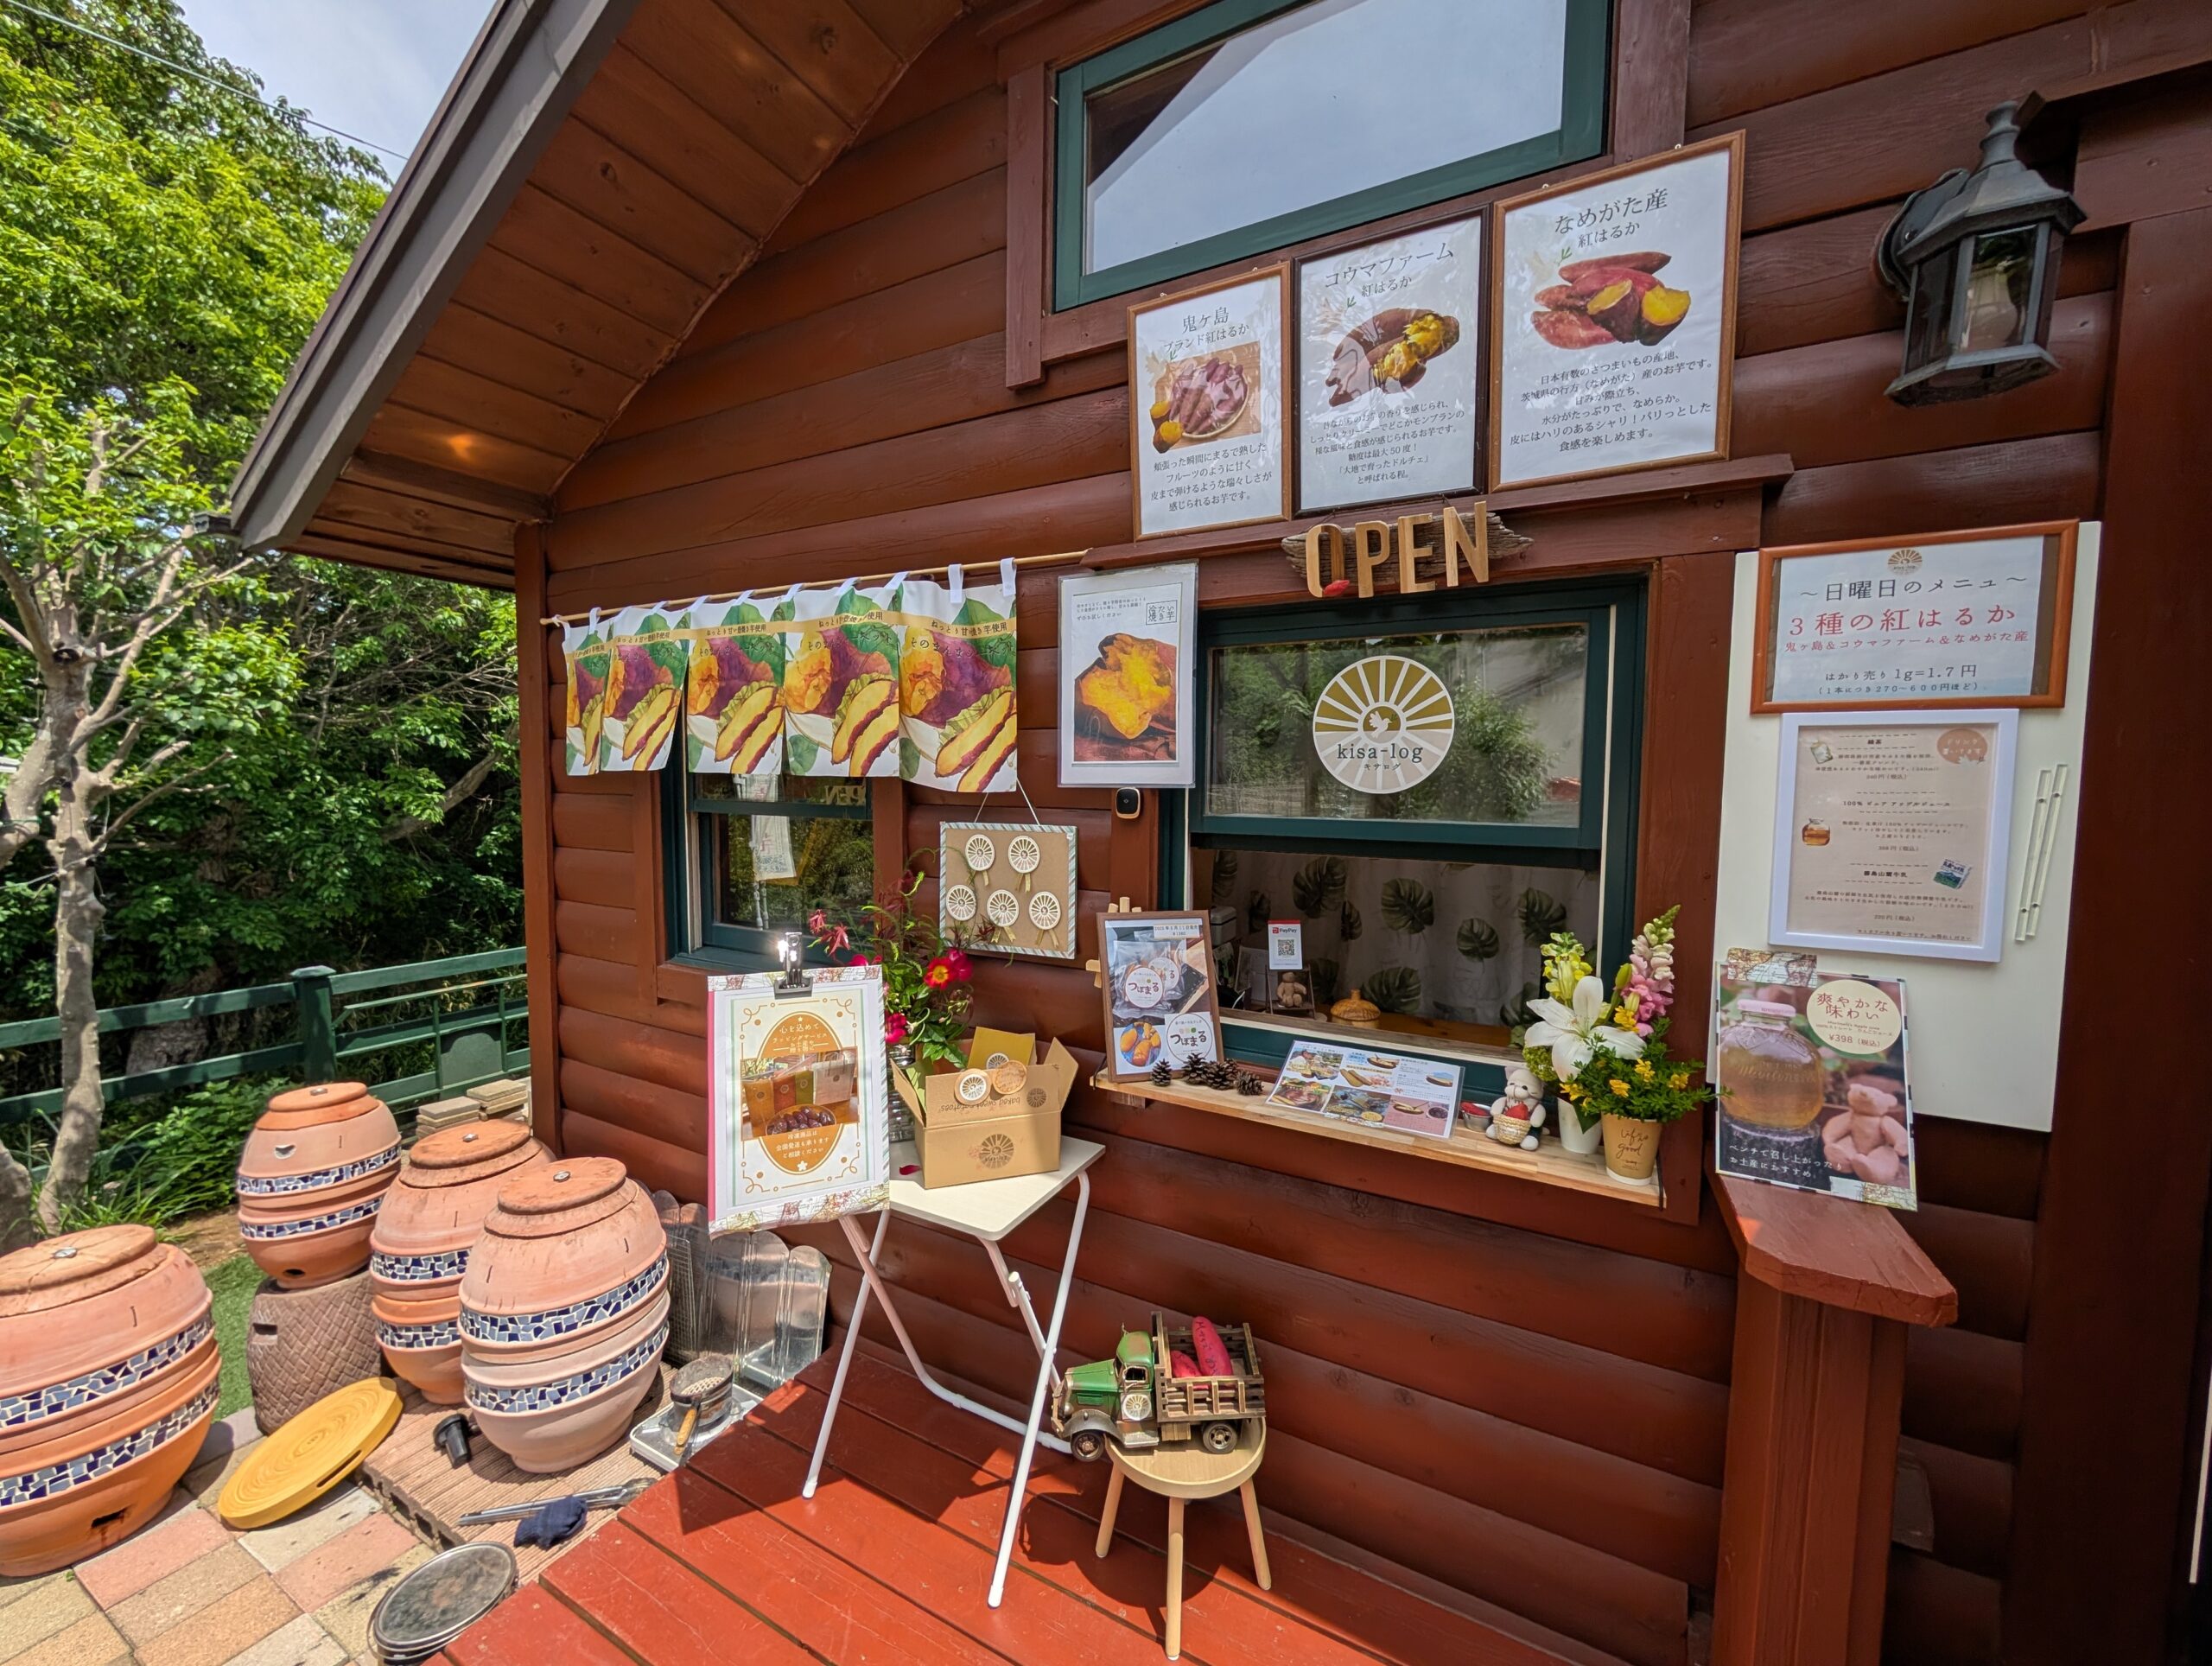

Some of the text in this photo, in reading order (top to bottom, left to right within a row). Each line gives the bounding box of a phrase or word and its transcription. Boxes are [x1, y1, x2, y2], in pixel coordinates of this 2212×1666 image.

[1554, 188, 1668, 235] なめがた産
[1578, 221, 1640, 249] 紅はるか
[1325, 243, 1453, 289] コウマファーム
[1361, 277, 1412, 297] 紅はるか
[1164, 323, 1249, 353] ブランド紅はるか
[1541, 350, 1681, 385] 日本有数のさつまいもの産地、
[1541, 392, 1681, 426] 水分がたっぷりで、なめらか。
[1575, 386, 1642, 406] 甘みが際立ち、
[1559, 428, 1655, 453] 食感を楽しめます。
[1154, 442, 1267, 473] 頬張った瞬間にまるで熟した
[1166, 459, 1251, 484] フルーツのように甘く
[1151, 471, 1272, 502] 皮まで弾けるような瑞々しさが
[1168, 490, 1251, 512] 感じられるお芋です。
[1306, 500, 1489, 598] OPEN
[1789, 604, 2016, 638] 3種の紅はるか
[1337, 744, 1423, 764] kisa-log
[1817, 993, 1888, 1013] 爽やかな
[1826, 1003, 1879, 1020] 味わい
[779, 1023, 820, 1034] 心を込めて
[1829, 1033, 1853, 1044] ¥398
